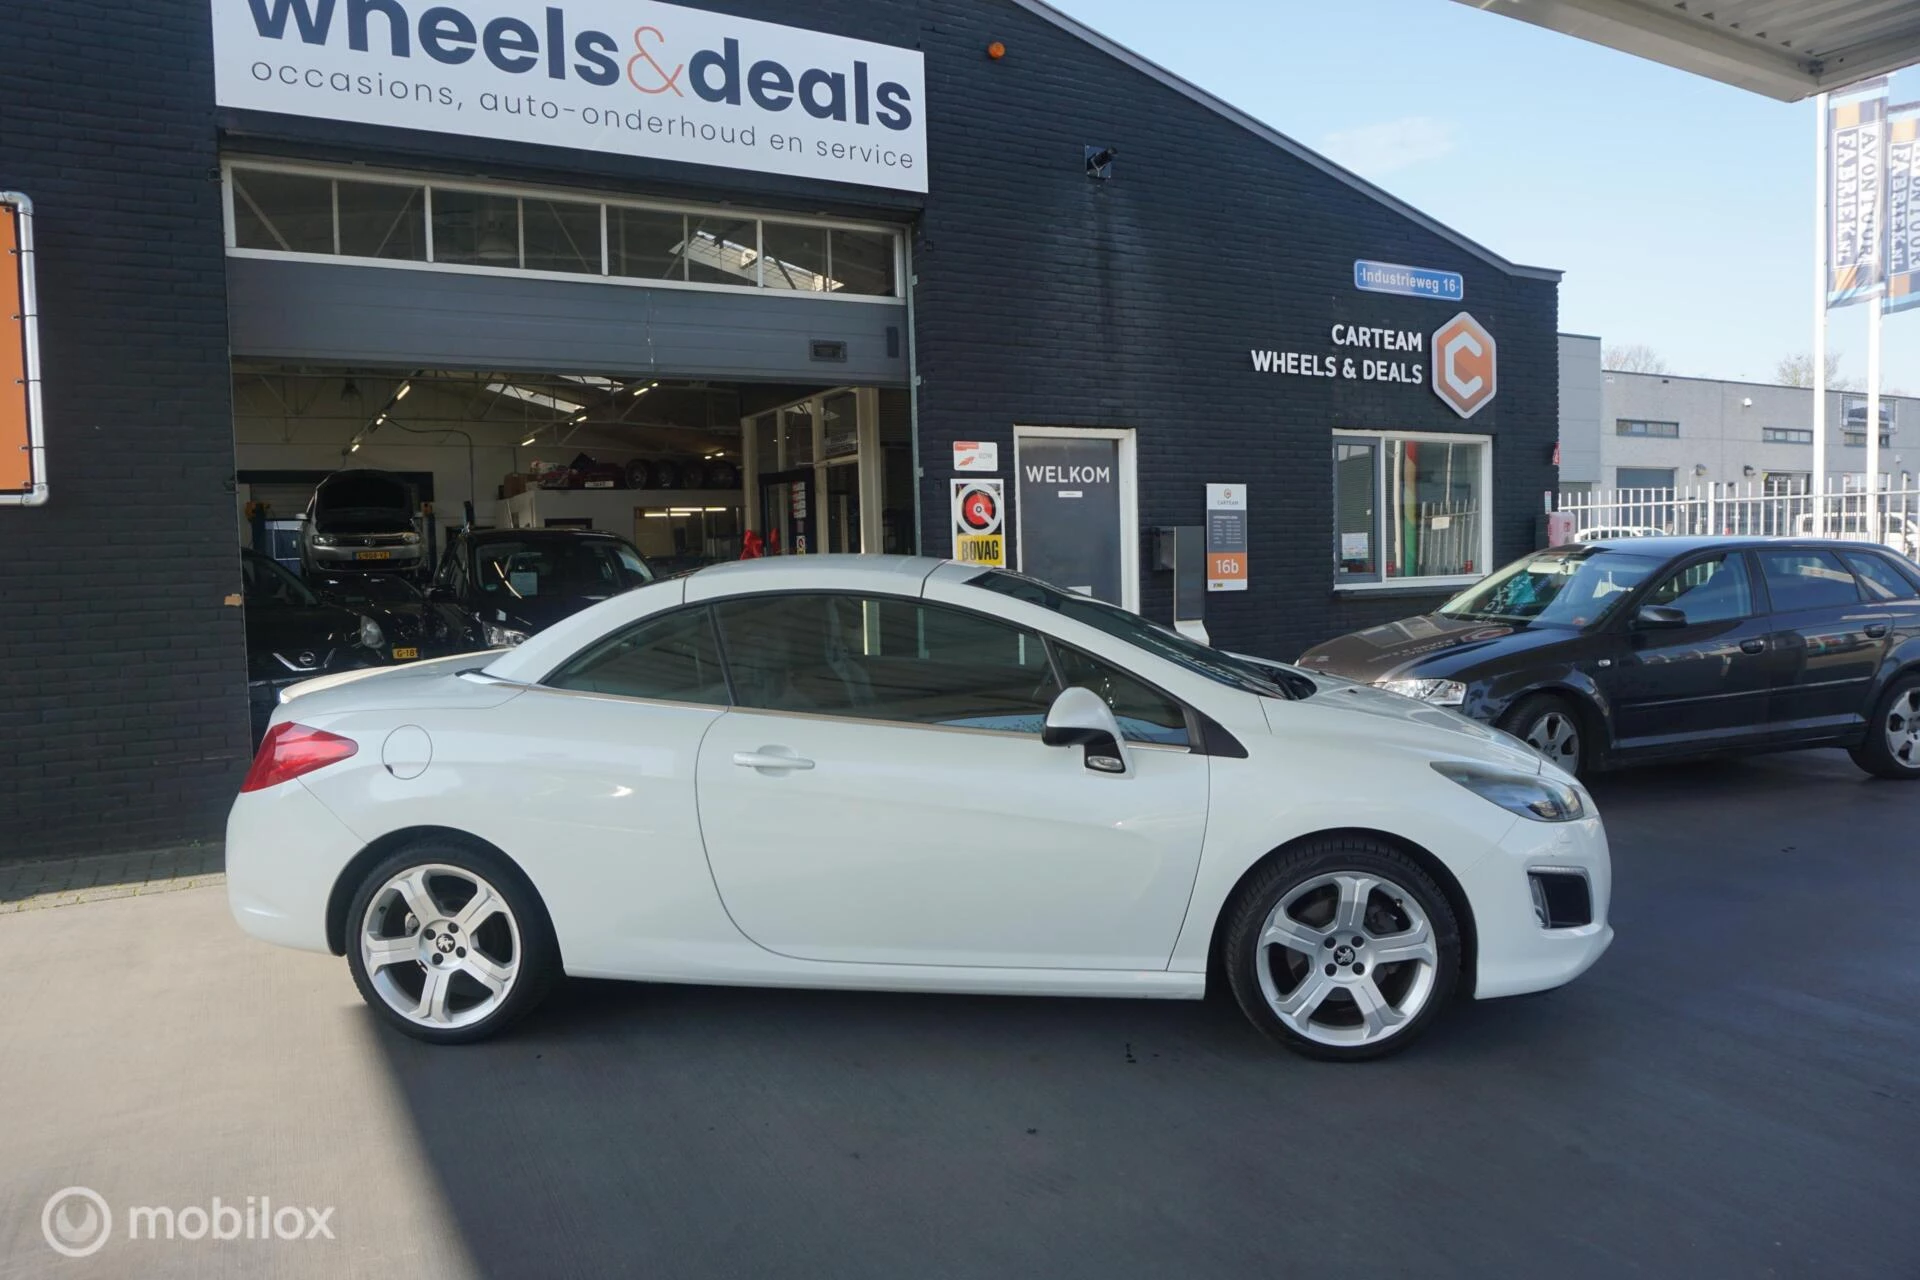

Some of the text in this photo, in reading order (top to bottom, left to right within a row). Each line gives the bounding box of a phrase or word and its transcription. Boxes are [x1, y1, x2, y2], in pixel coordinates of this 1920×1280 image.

[251, 61, 913, 169] occasions, auto-onderhoud en service
[1860, 132, 1876, 262] AVONTUUR
[1362, 267, 1456, 294] Industrieweg 16
[1331, 324, 1422, 352] CARTEAM
[1251, 350, 1423, 384] WHEELS & DEALS
[1025, 465, 1110, 484] WELKOM
[961, 540, 999, 561] BOVAG
[1216, 559, 1239, 574] 16b
